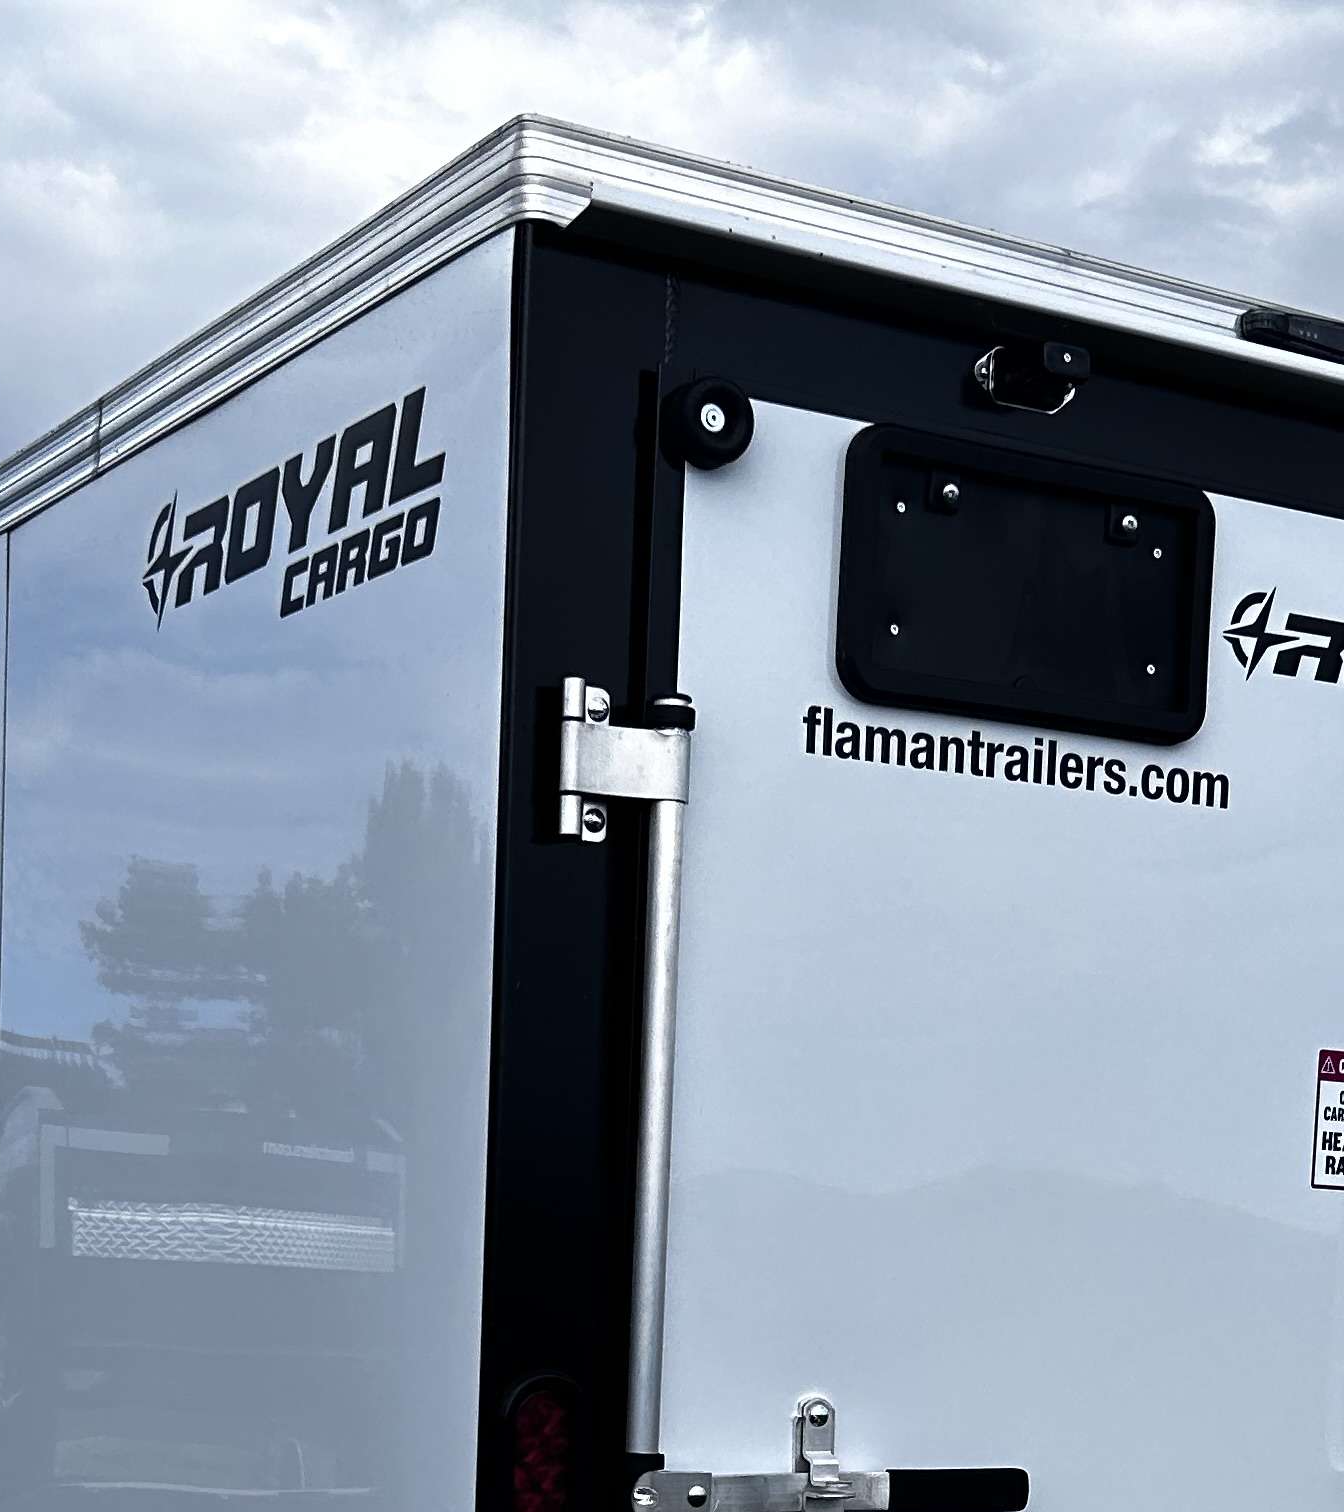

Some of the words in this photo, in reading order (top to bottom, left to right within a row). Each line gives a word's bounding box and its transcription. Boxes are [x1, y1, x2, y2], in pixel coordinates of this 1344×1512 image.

[174, 385, 446, 609] ROYAL
[279, 496, 441, 619] CARGO
[801, 705, 1231, 810] flamantrailers.com
